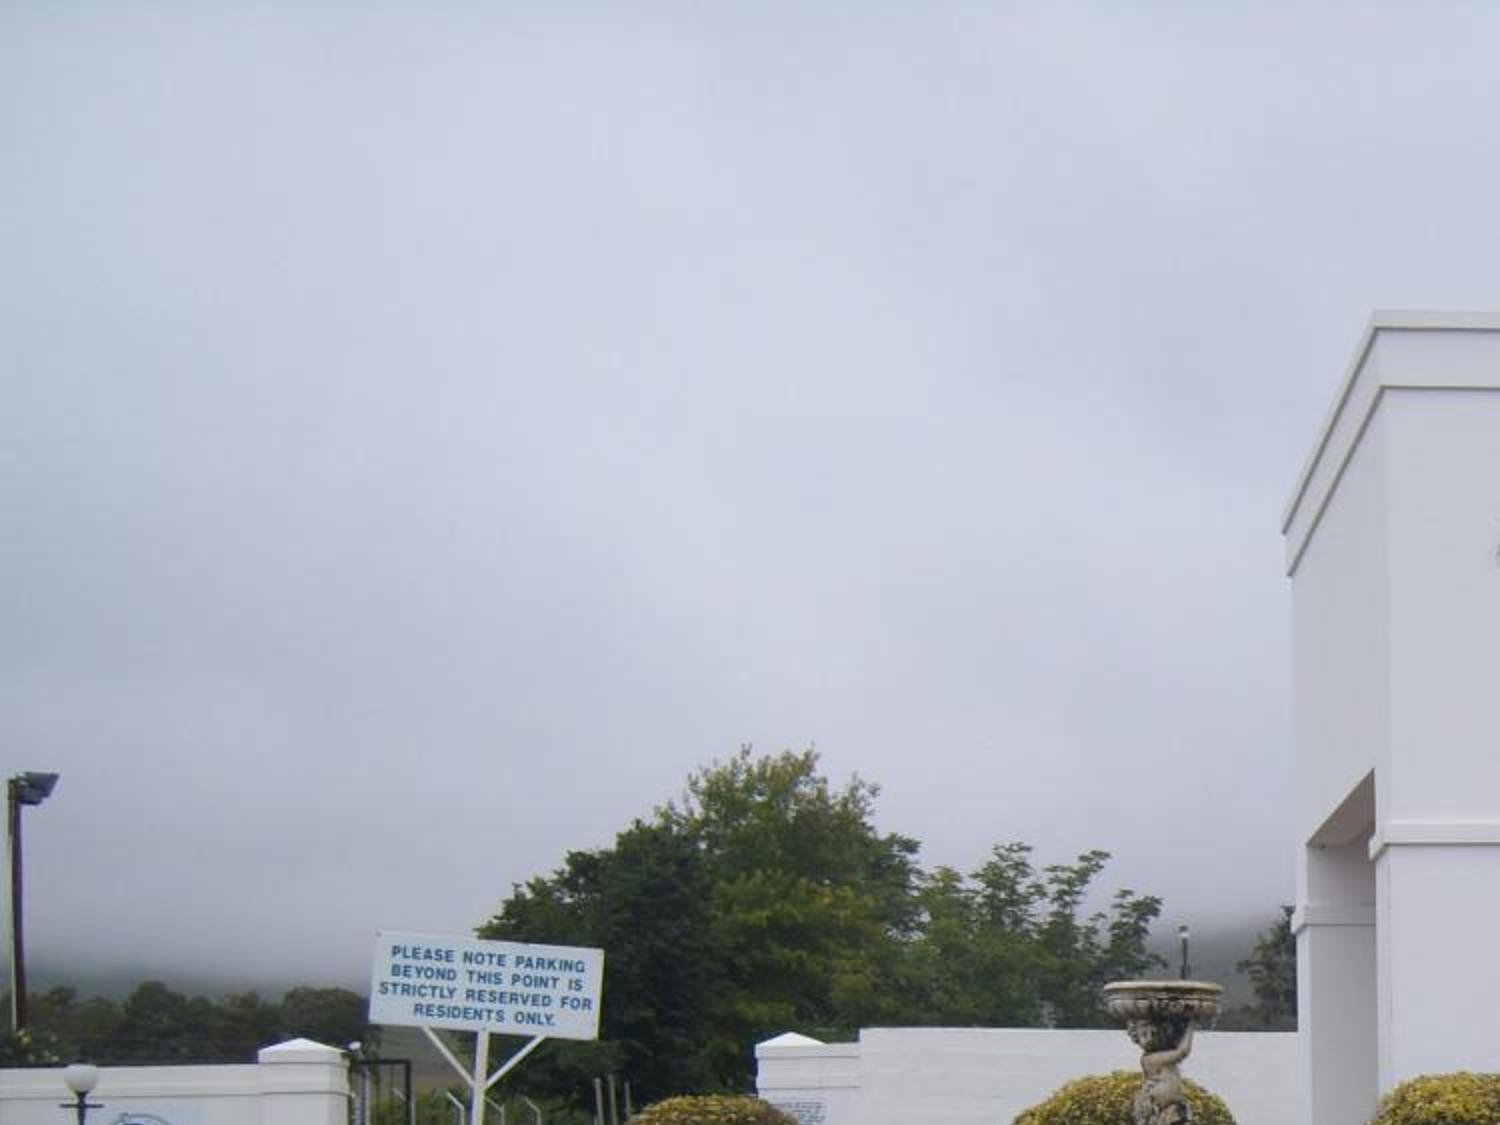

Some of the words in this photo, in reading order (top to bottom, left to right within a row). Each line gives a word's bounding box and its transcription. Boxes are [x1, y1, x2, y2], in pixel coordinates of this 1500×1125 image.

[391, 945, 454, 963] PLEASE
[463, 950, 506, 967] NOTE
[515, 955, 586, 973] PARKING
[391, 964, 457, 981] BEYOND
[467, 969, 503, 986] THIS
[511, 973, 560, 989] POINT
[568, 977, 583, 991] IS
[379, 981, 458, 999] STRICTLY
[465, 988, 552, 1007] RESERVED
[560, 996, 593, 1011] FOR
[413, 1003, 505, 1023] RESIDENTS
